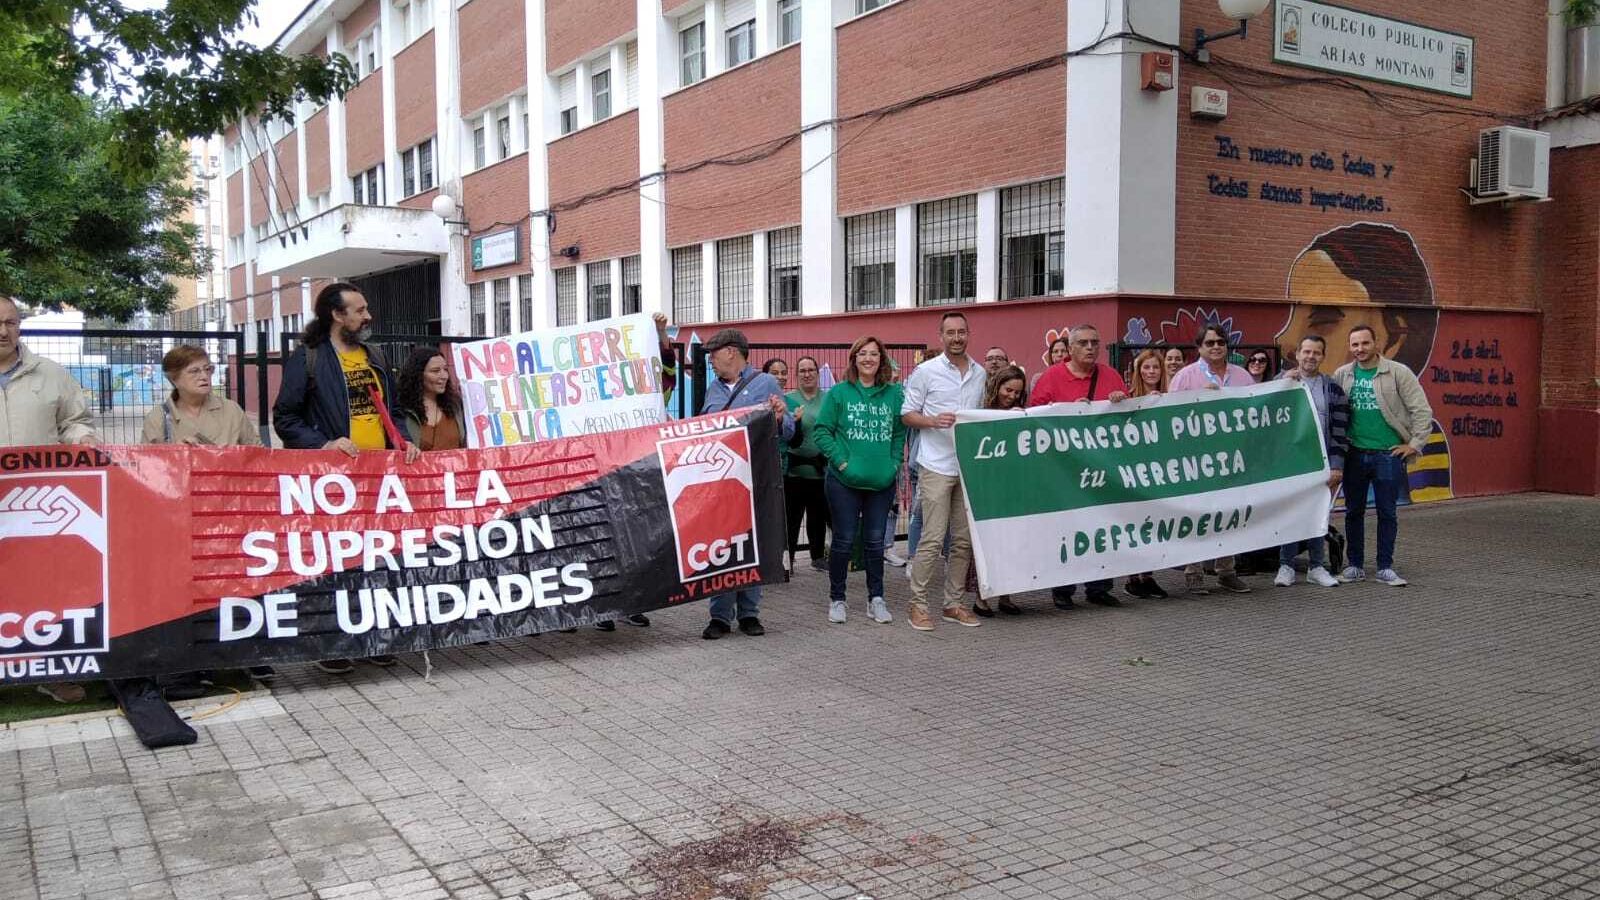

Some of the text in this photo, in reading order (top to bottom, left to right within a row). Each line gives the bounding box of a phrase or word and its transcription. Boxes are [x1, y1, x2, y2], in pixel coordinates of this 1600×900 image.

[1312, 11, 1444, 53] COLEGIO PUBLICO
[1320, 45, 1434, 80] ARIAS MONTANO
[1214, 135, 1240, 160] En
[1248, 146, 1303, 167] nuestro
[1383, 164, 1393, 179] y
[461, 324, 640, 379] NO AL CIERRE
[1450, 340, 1460, 359] 2
[1462, 339, 1473, 359] de
[582, 368, 595, 383] EN
[585, 387, 599, 403] LA
[596, 355, 663, 400] ESCUELA
[1488, 368, 1499, 385] de
[1502, 366, 1514, 385] la
[467, 379, 501, 415] DE
[658, 415, 741, 439] HUELVA
[974, 405, 1291, 460] La EDUCACIÓN PÚBLICA es
[1451, 412, 1503, 438] autismo
[1079, 449, 1246, 489] tu HERENCIA
[278, 469, 513, 516] NO A LA
[241, 508, 556, 577] SUPRESIÓN
[687, 533, 750, 571] CGT
[1059, 504, 1254, 564] ¡DEFIÉNDELA!
[701, 569, 762, 594] LUCHA
[219, 562, 594, 642] DE UNIDADES
[0, 607, 96, 648] CGT
